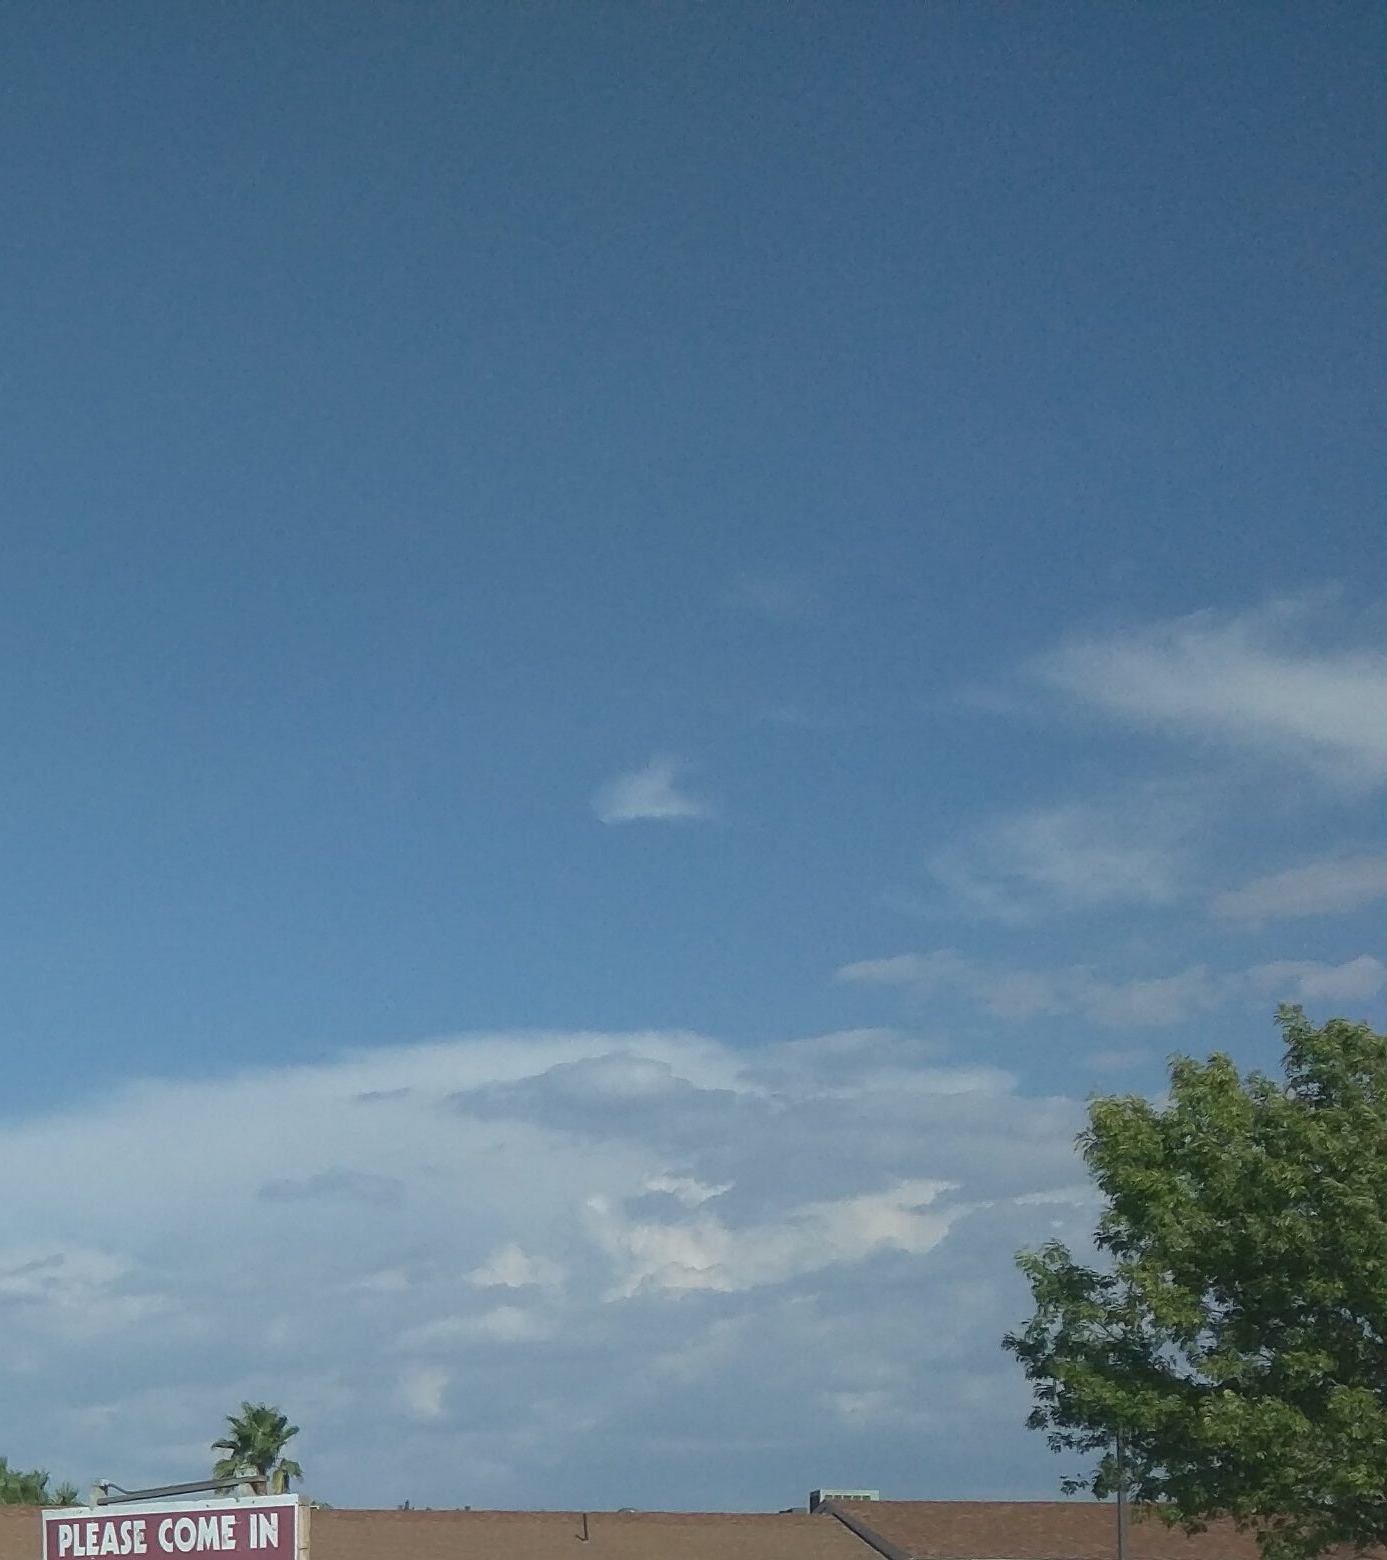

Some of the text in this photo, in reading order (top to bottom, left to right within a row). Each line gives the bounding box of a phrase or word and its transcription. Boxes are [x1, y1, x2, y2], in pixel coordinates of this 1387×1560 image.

[58, 1512, 279, 1558] PLEASE COME IN
